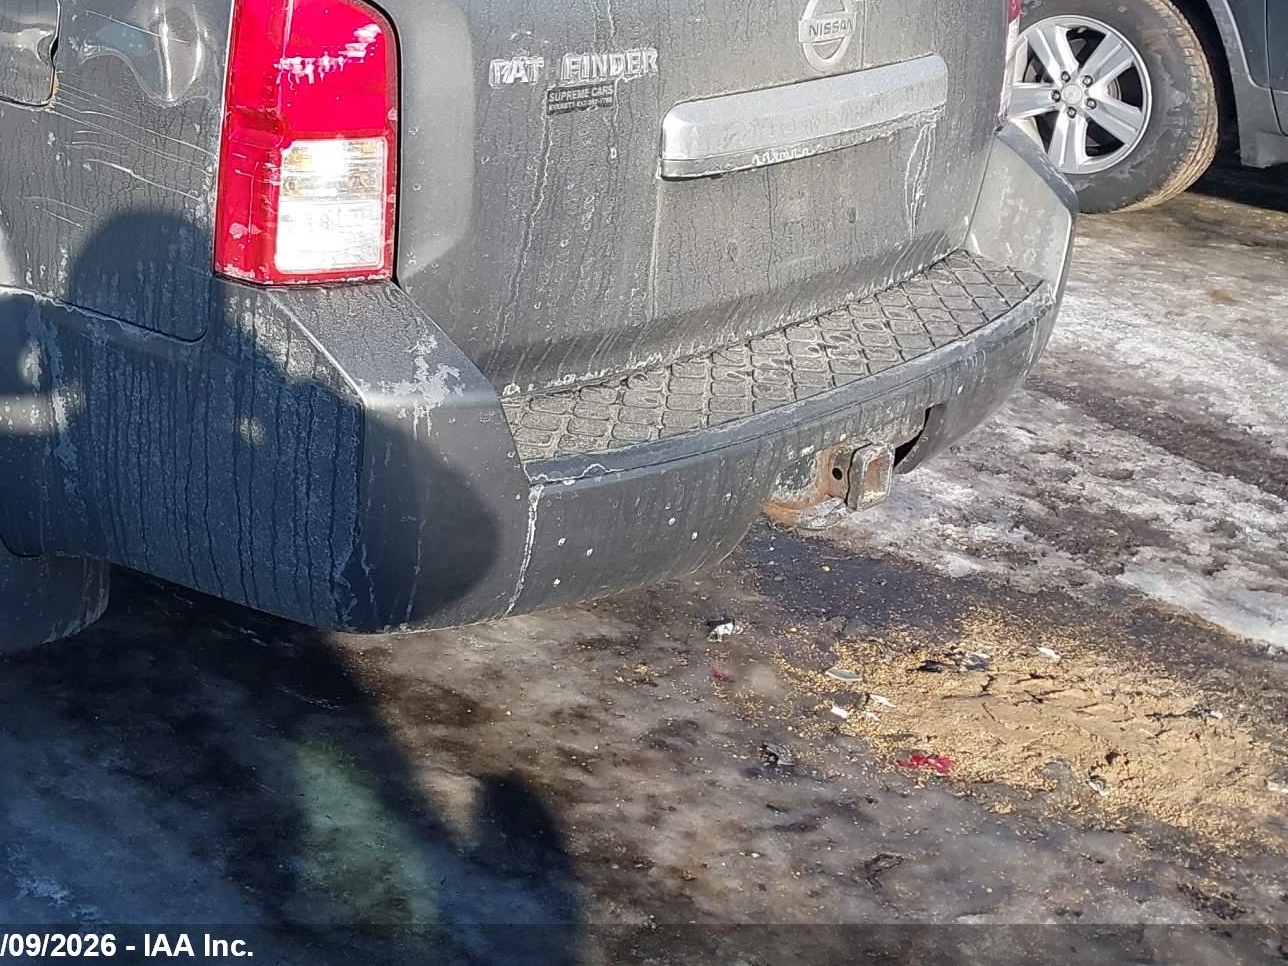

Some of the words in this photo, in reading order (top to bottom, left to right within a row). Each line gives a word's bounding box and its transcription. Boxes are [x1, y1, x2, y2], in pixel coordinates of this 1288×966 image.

[808, 18, 855, 37] NISSAN
[548, 89, 590, 103] SUPREME
[591, 85, 614, 97] CARS
